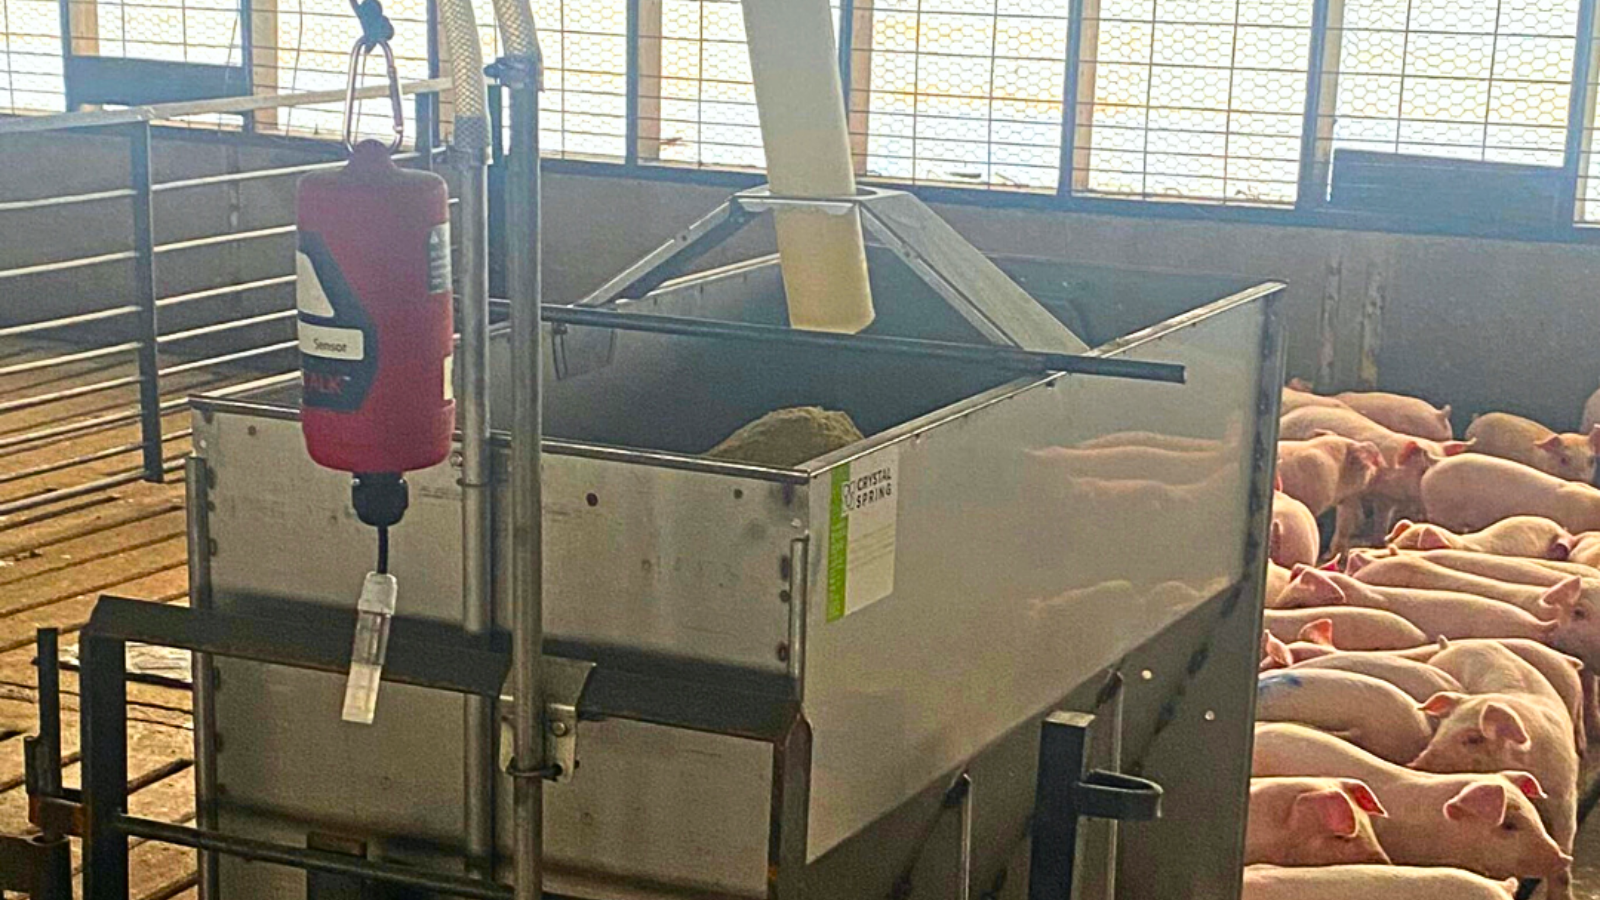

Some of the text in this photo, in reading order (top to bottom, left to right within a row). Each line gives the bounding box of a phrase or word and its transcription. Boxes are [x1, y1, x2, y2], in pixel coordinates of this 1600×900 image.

[313, 338, 347, 352] Sensor
[857, 467, 892, 491] CRYSTAL
[856, 482, 892, 509] SPRING
